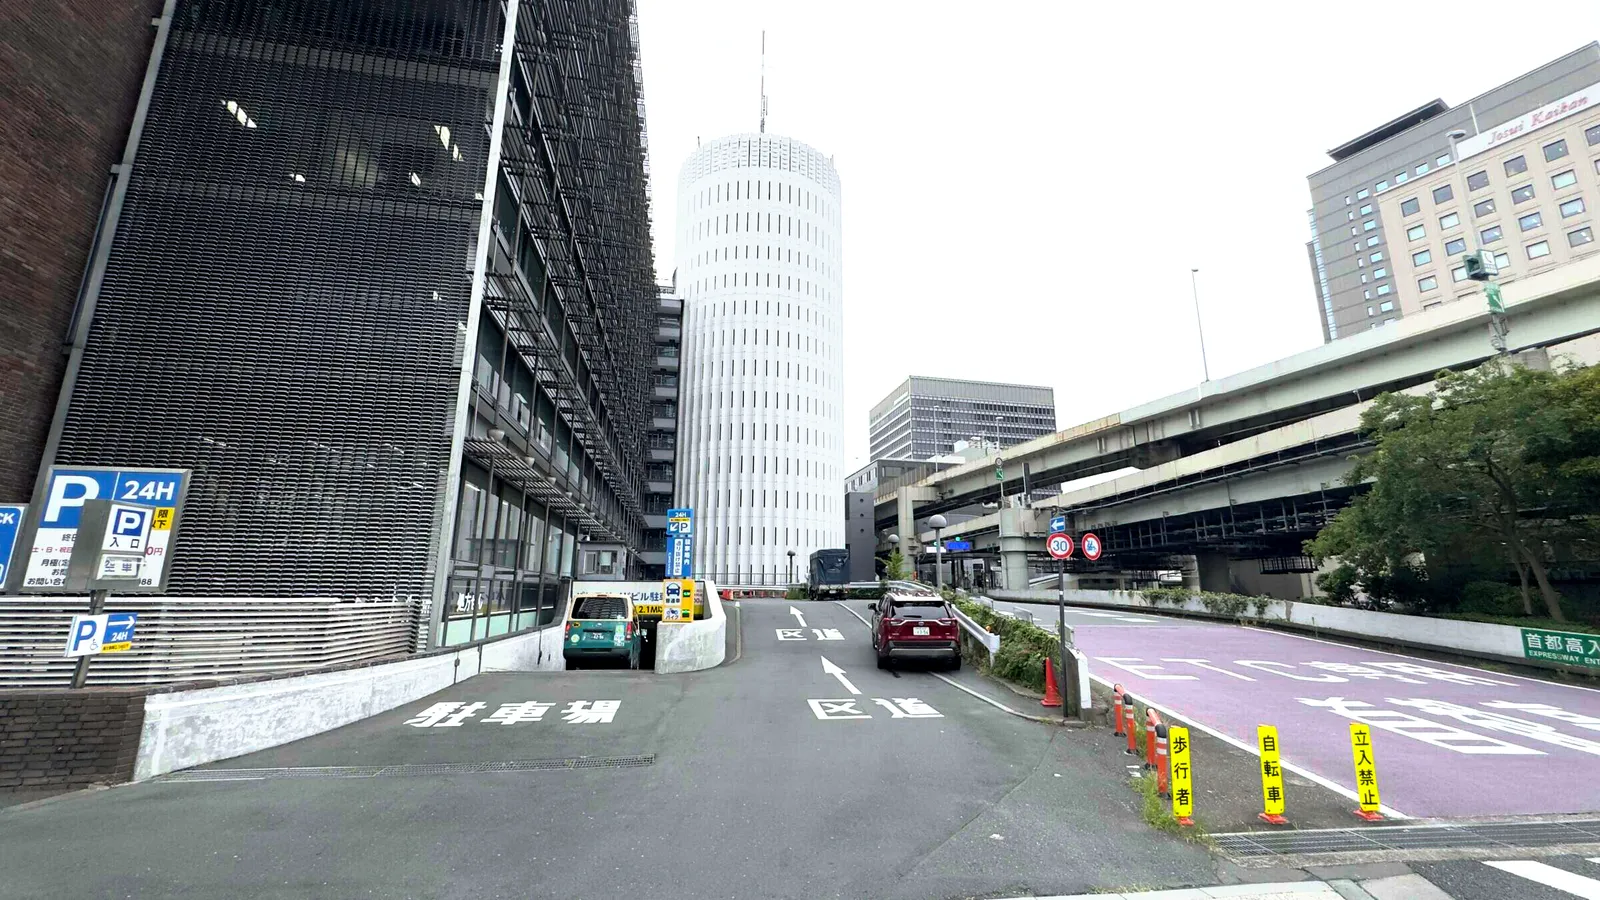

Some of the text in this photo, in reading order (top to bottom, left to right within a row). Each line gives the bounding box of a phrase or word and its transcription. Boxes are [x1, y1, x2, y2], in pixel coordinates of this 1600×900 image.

[1488, 96, 1588, 145] Josui Kaikan
[44, 475, 99, 522] P
[121, 480, 175, 500] 24H
[116, 511, 141, 534] P
[680, 522, 688, 531] P
[109, 537, 140, 549] 入口
[1053, 540, 1068, 552] 30
[73, 620, 97, 651] P
[111, 631, 128, 641] 24H
[775, 628, 846, 641] 区道
[1528, 650, 1579, 662] EXPRESSWAY
[403, 699, 622, 728] 駐車場
[806, 698, 945, 720] 区道
[1172, 737, 1190, 806] 歩行者
[1263, 735, 1282, 803] 自転車
[1354, 729, 1378, 806] 立入禁止
